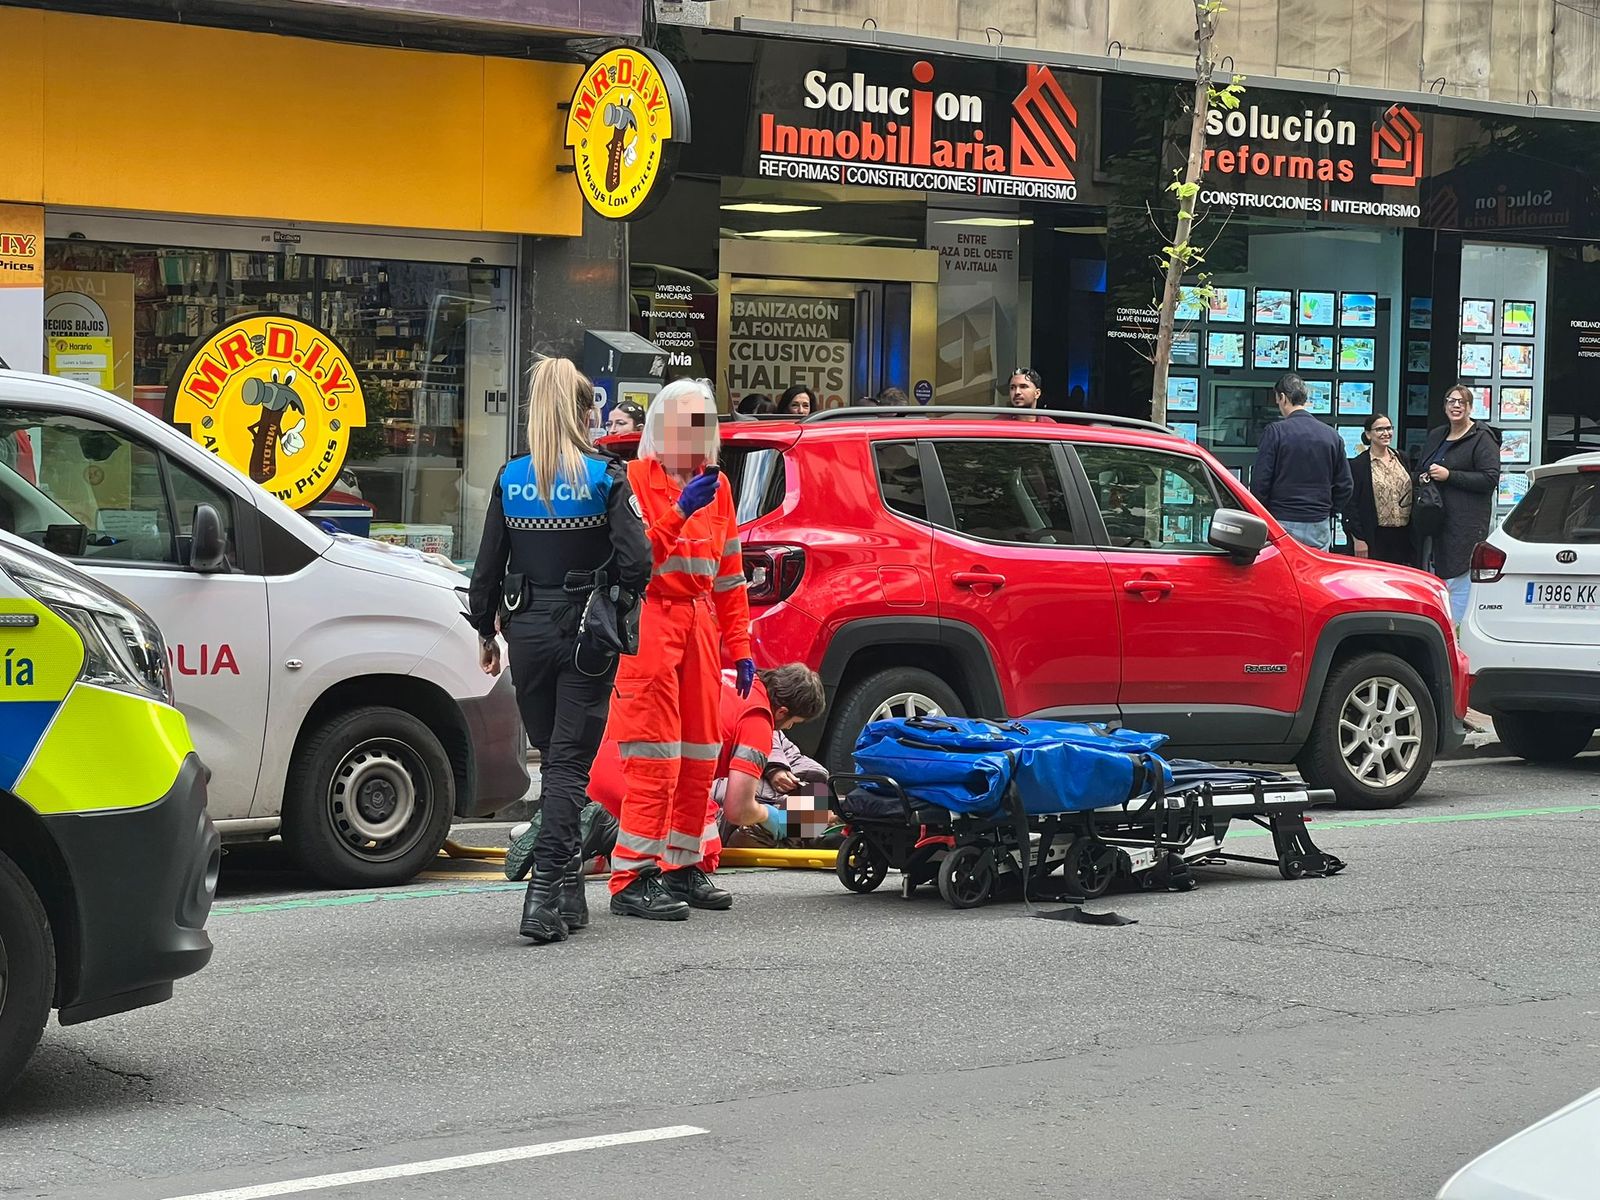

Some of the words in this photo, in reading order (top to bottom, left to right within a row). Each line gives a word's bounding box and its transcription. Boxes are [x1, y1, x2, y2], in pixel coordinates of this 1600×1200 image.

[575, 68, 611, 128] MR
[803, 61, 983, 124] Solucion
[1205, 105, 1356, 146] solución
[760, 113, 1006, 173] Inmobiliaria
[1202, 145, 1355, 183] reformas
[581, 154, 606, 203] Always
[608, 194, 629, 207] Low
[631, 150, 655, 197] Prices
[759, 160, 840, 182] REFORMAS
[846, 166, 976, 193] CONSTRUCCIONES
[982, 179, 1077, 201] INTERIORISMO
[1200, 190, 1322, 211] CONSTRUCCIONES
[1331, 199, 1421, 218] INTERIORISMO
[957, 233, 987, 245] ENTRE
[963, 247, 981, 258] DEL
[983, 249, 1013, 260] OESTE
[945, 260, 952, 271] Y
[657, 284, 691, 293] VIVIENDAS
[654, 293, 693, 301] BANCARIAS
[641, 310, 688, 319] FINANCIACIÓN
[689, 312, 705, 320] 100%
[731, 301, 839, 321] BANIZACIÓN
[75, 320, 104, 331] BAJOS
[1116, 315, 1133, 323] LLAVE
[1143, 316, 1160, 324] MANO
[655, 331, 692, 339] VENDEDOR
[752, 321, 829, 339] FONTANA
[1107, 330, 1137, 339] REFORMAS
[69, 342, 93, 351] Horario
[187, 331, 255, 406] MR
[266, 325, 352, 408] D.I.Y.
[295, 439, 338, 493] Prices
[1558, 552, 1575, 561] KIA
[1538, 585, 1572, 602] 1986
[1576, 585, 1598, 603] KK
[1244, 664, 1288, 674] RENEGADE
